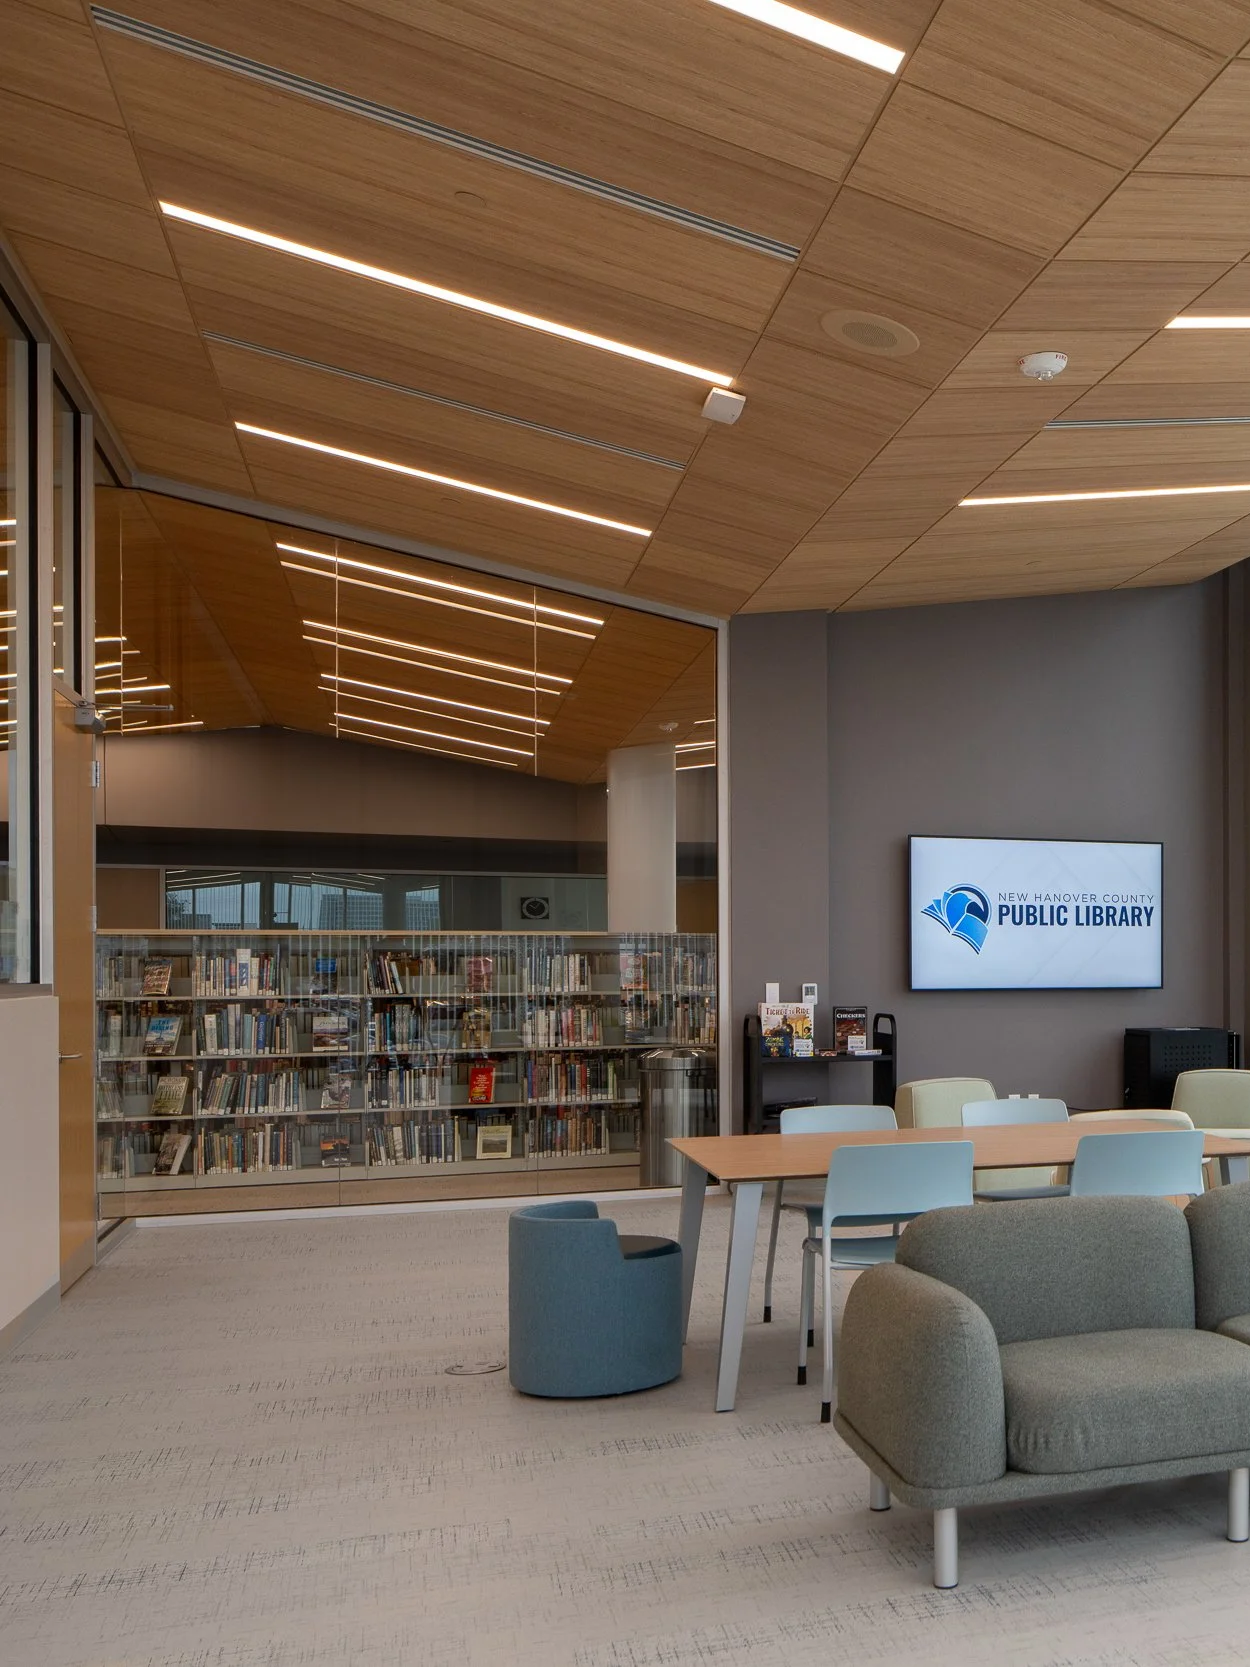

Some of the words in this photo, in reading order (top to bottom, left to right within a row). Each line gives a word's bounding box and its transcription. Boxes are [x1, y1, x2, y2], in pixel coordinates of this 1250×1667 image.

[998, 892, 1029, 902] NEW
[1034, 893, 1097, 903] HANOVER
[1102, 894, 1155, 904] COUNTY
[998, 904, 1069, 927] PUBLIC
[1075, 905, 1155, 927] LIBRARY
